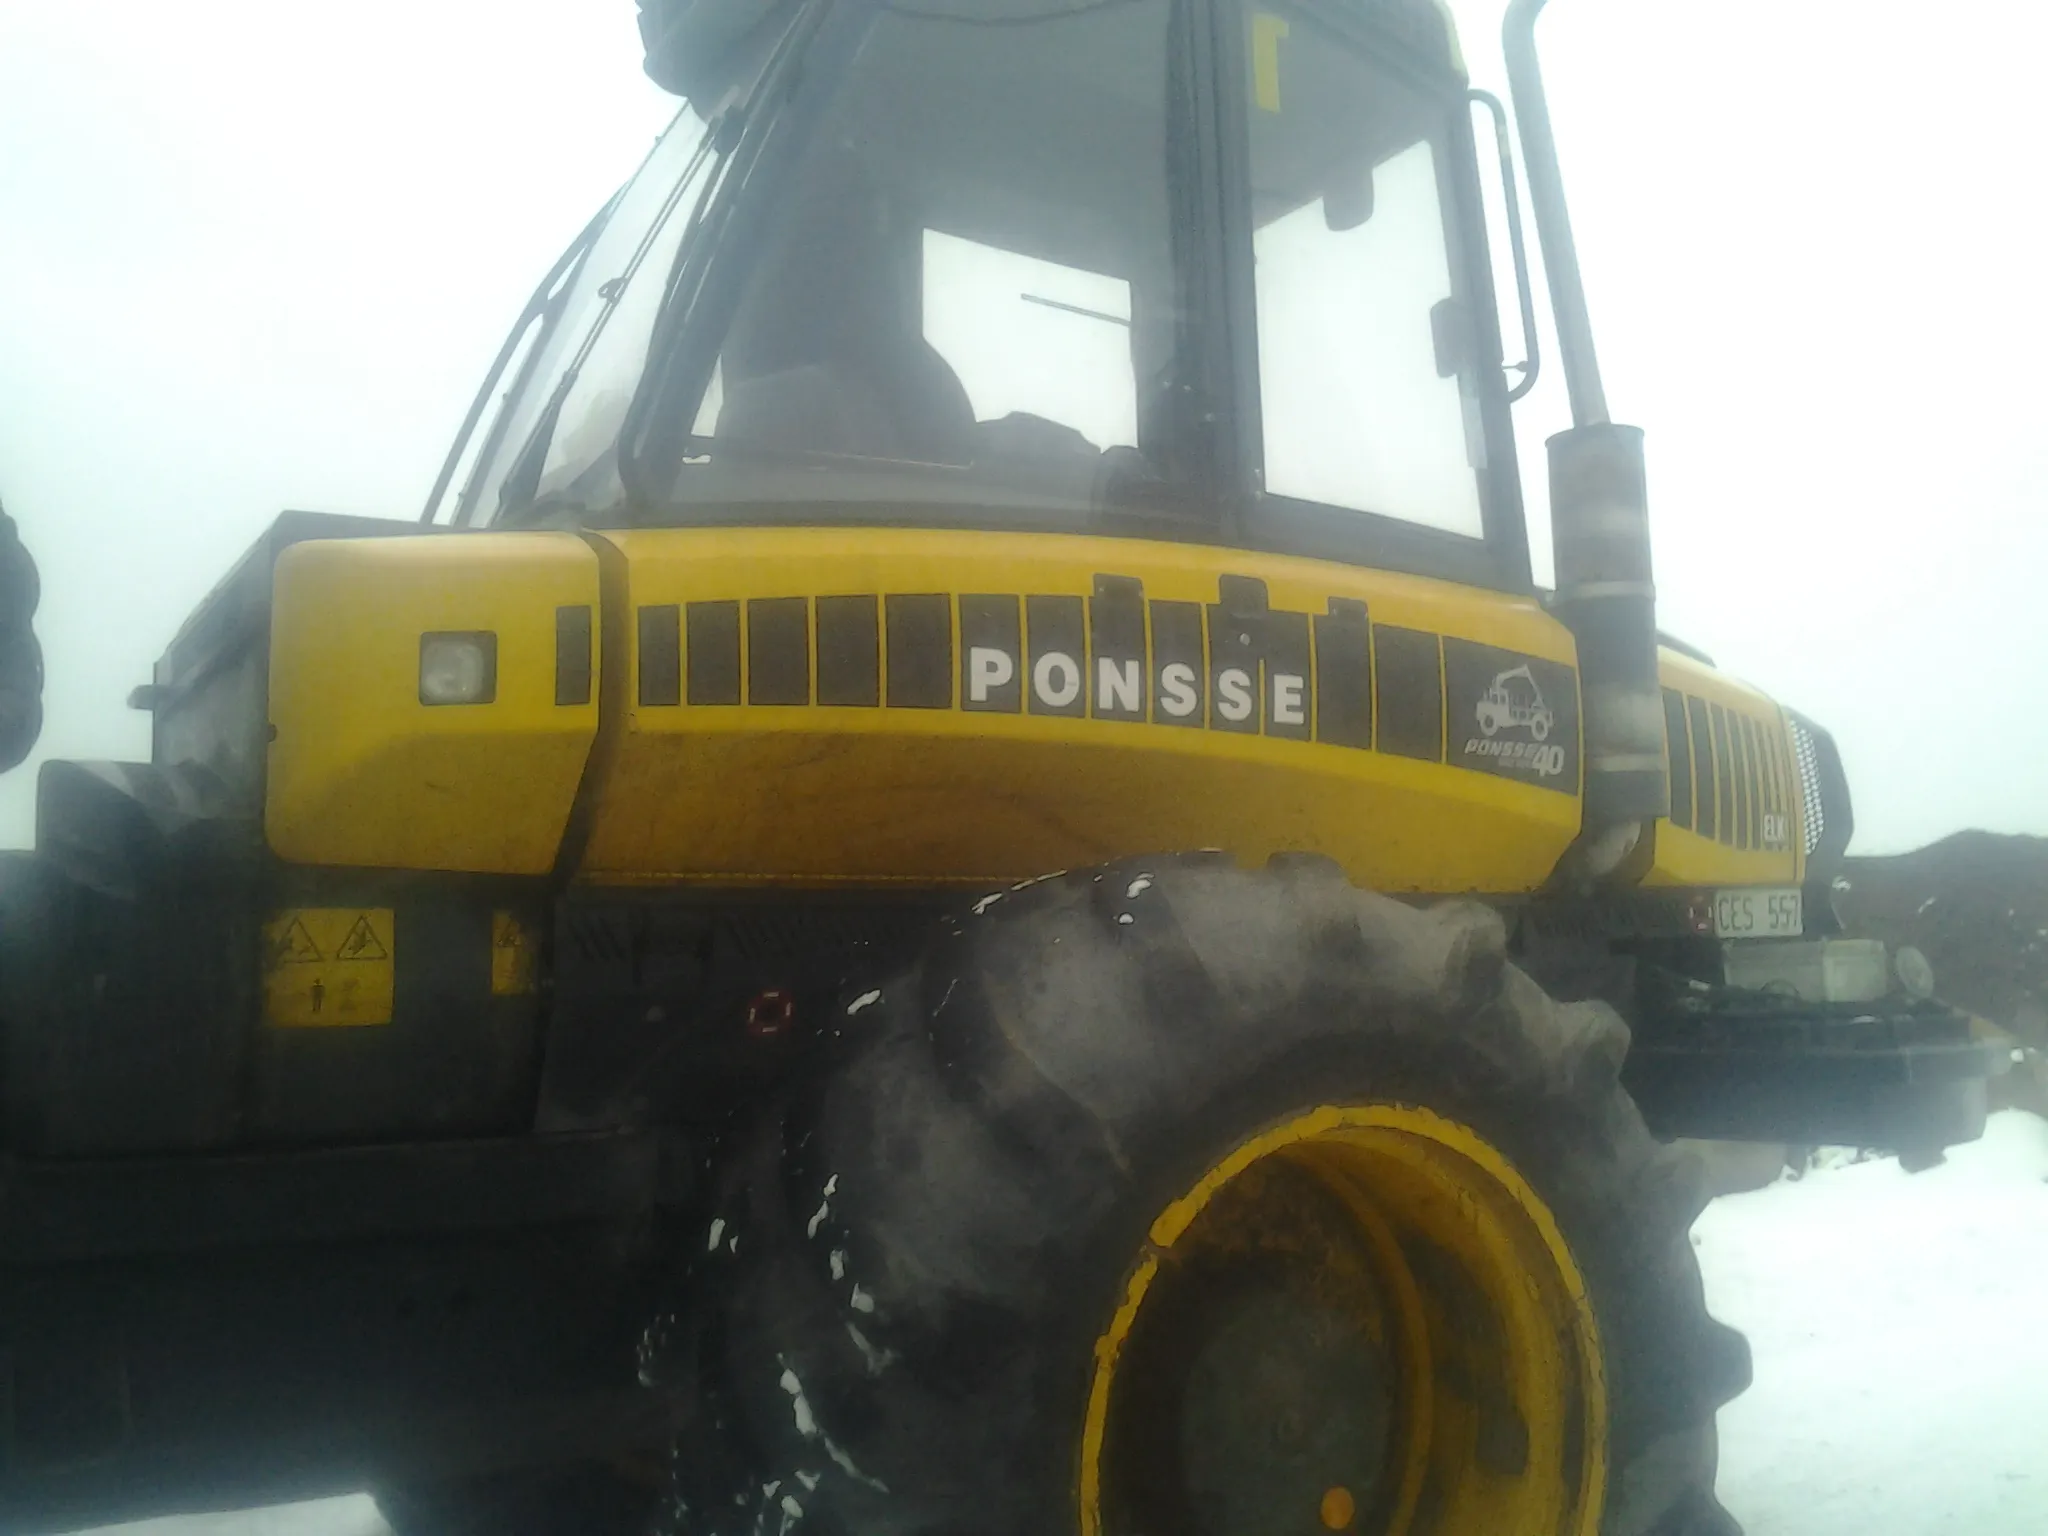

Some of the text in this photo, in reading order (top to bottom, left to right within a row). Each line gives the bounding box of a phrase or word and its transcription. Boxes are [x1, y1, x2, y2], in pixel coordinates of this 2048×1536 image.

[968, 646, 1305, 726] PONSSE
[1464, 738, 1537, 758] PONSSE
[1532, 744, 1565, 777] 40
[1719, 896, 1753, 931] CES
